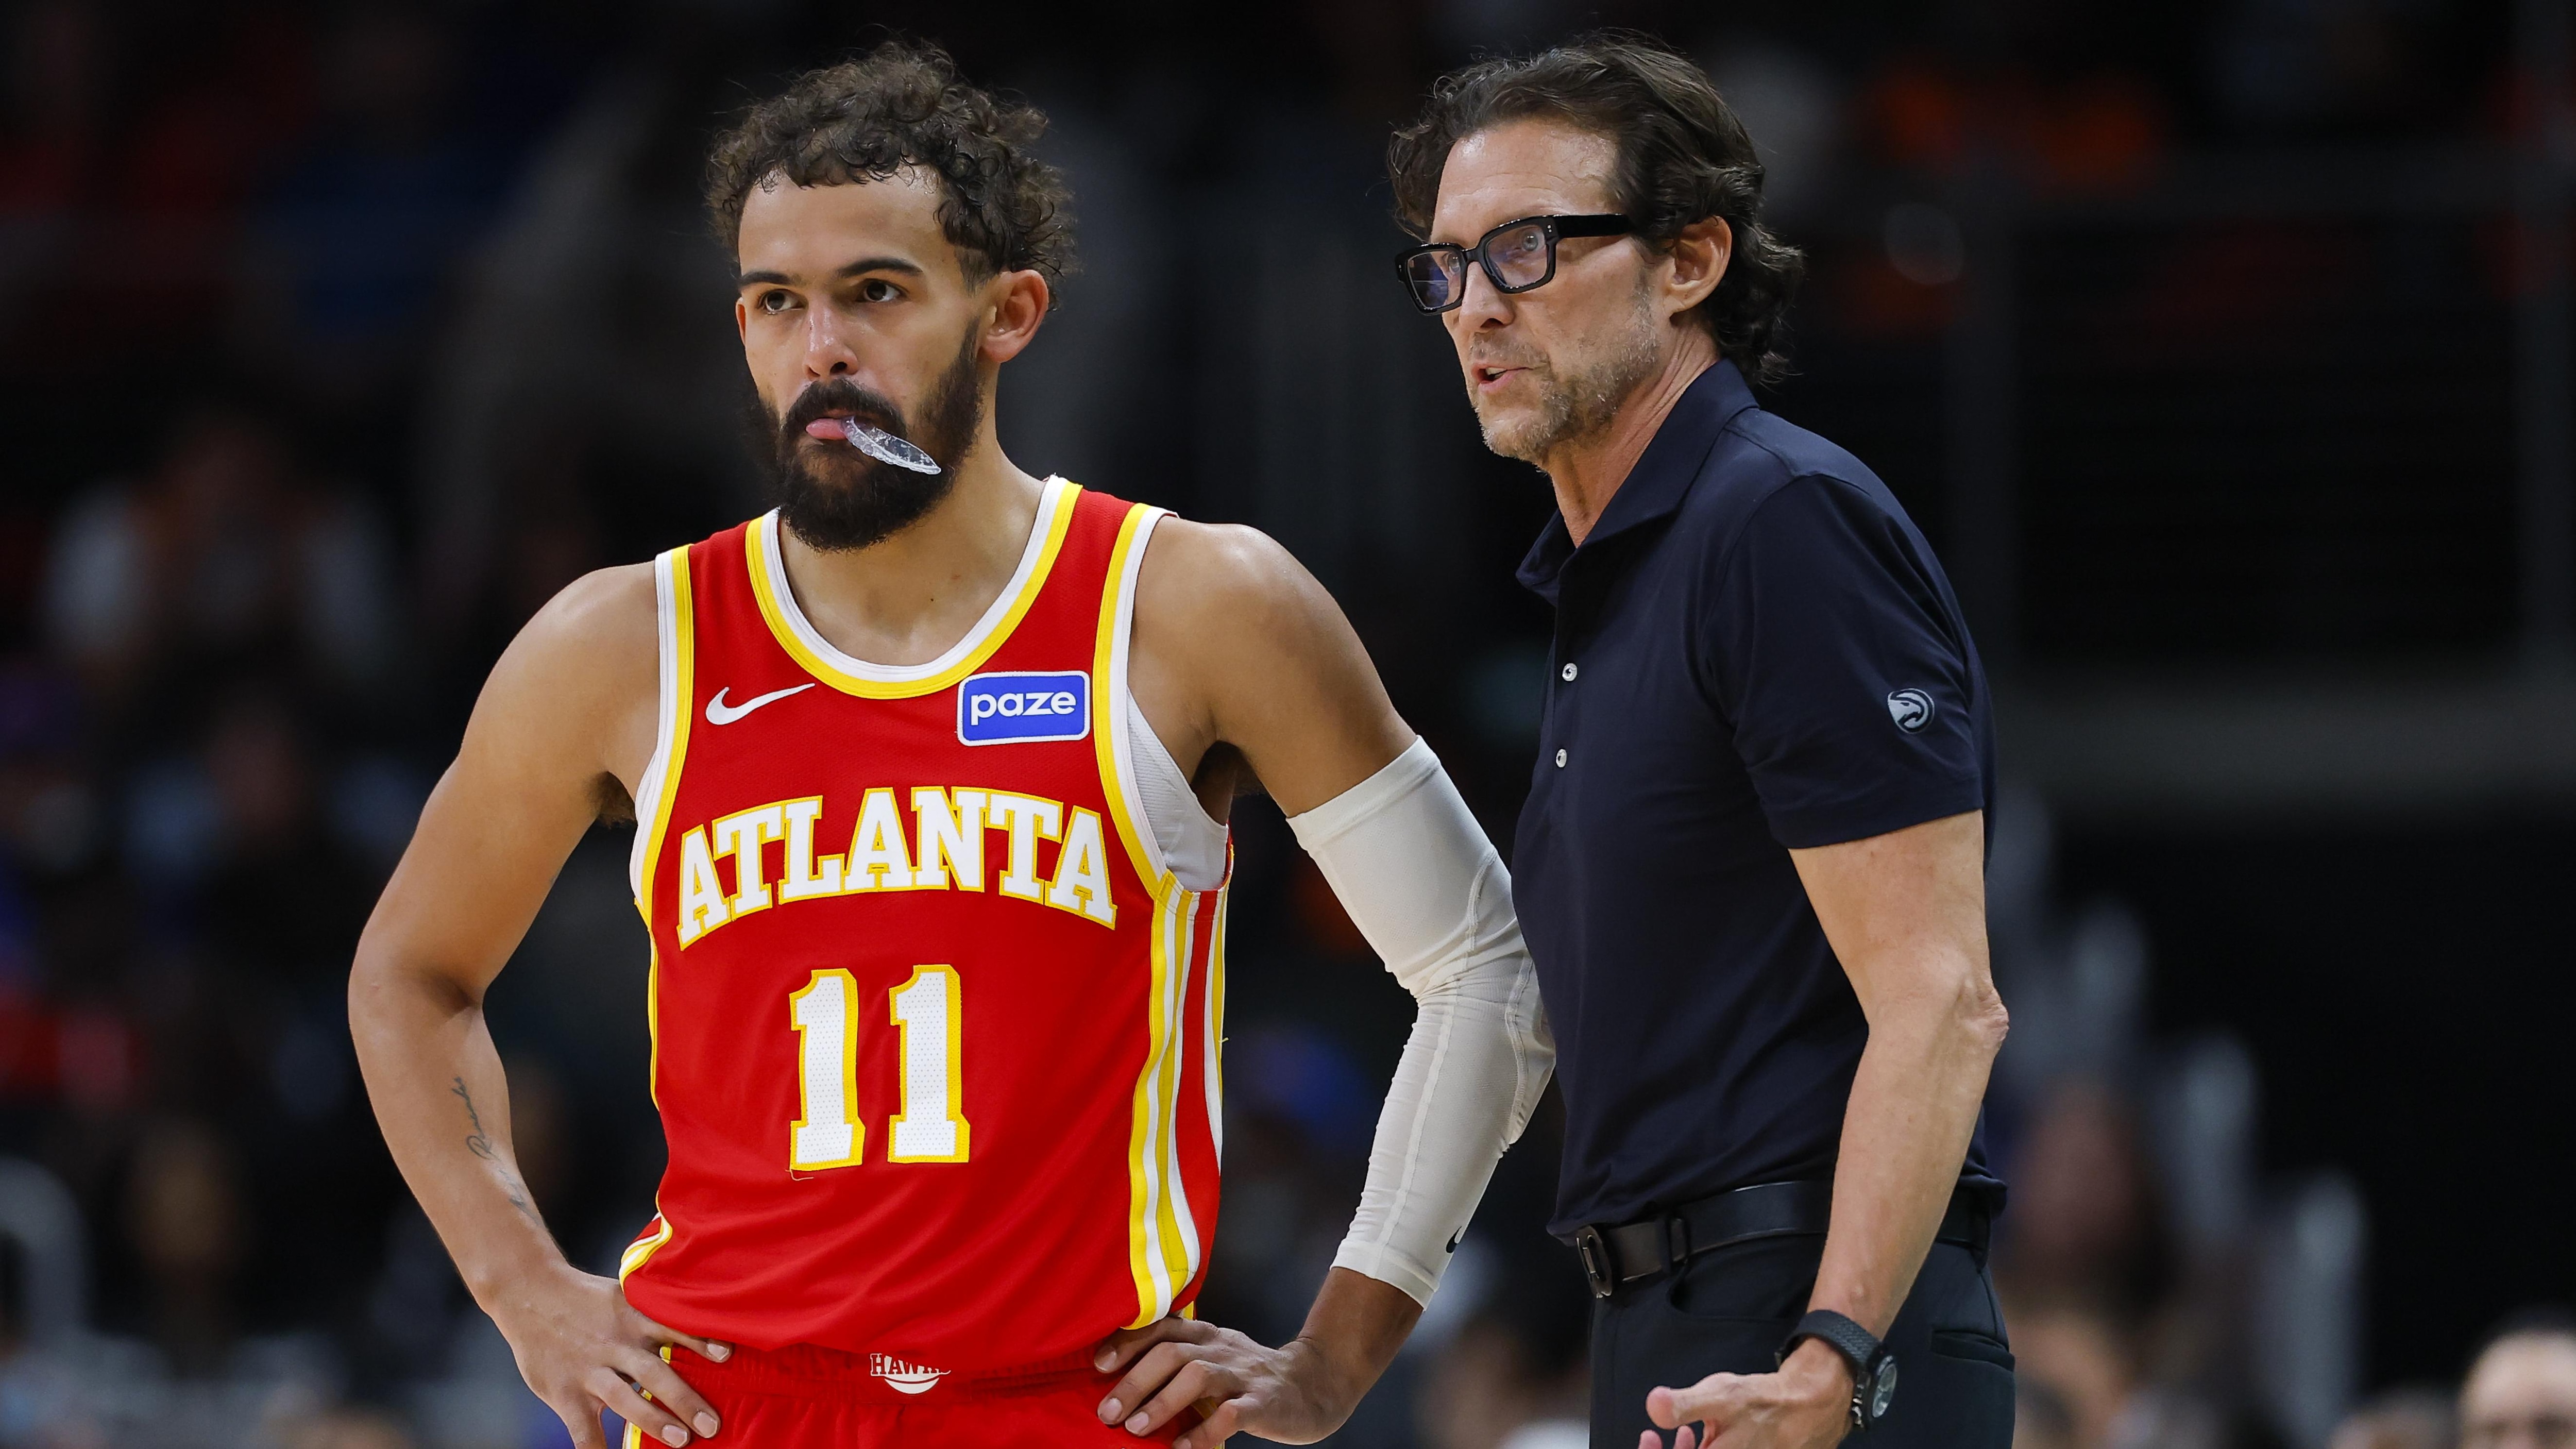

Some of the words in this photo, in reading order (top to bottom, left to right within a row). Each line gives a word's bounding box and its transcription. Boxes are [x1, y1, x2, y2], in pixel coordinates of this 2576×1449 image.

[971, 691, 1076, 726] paze
[676, 786, 1117, 951] ATLANTA
[790, 964, 971, 1170] 11
[870, 1353, 951, 1376] HAW
